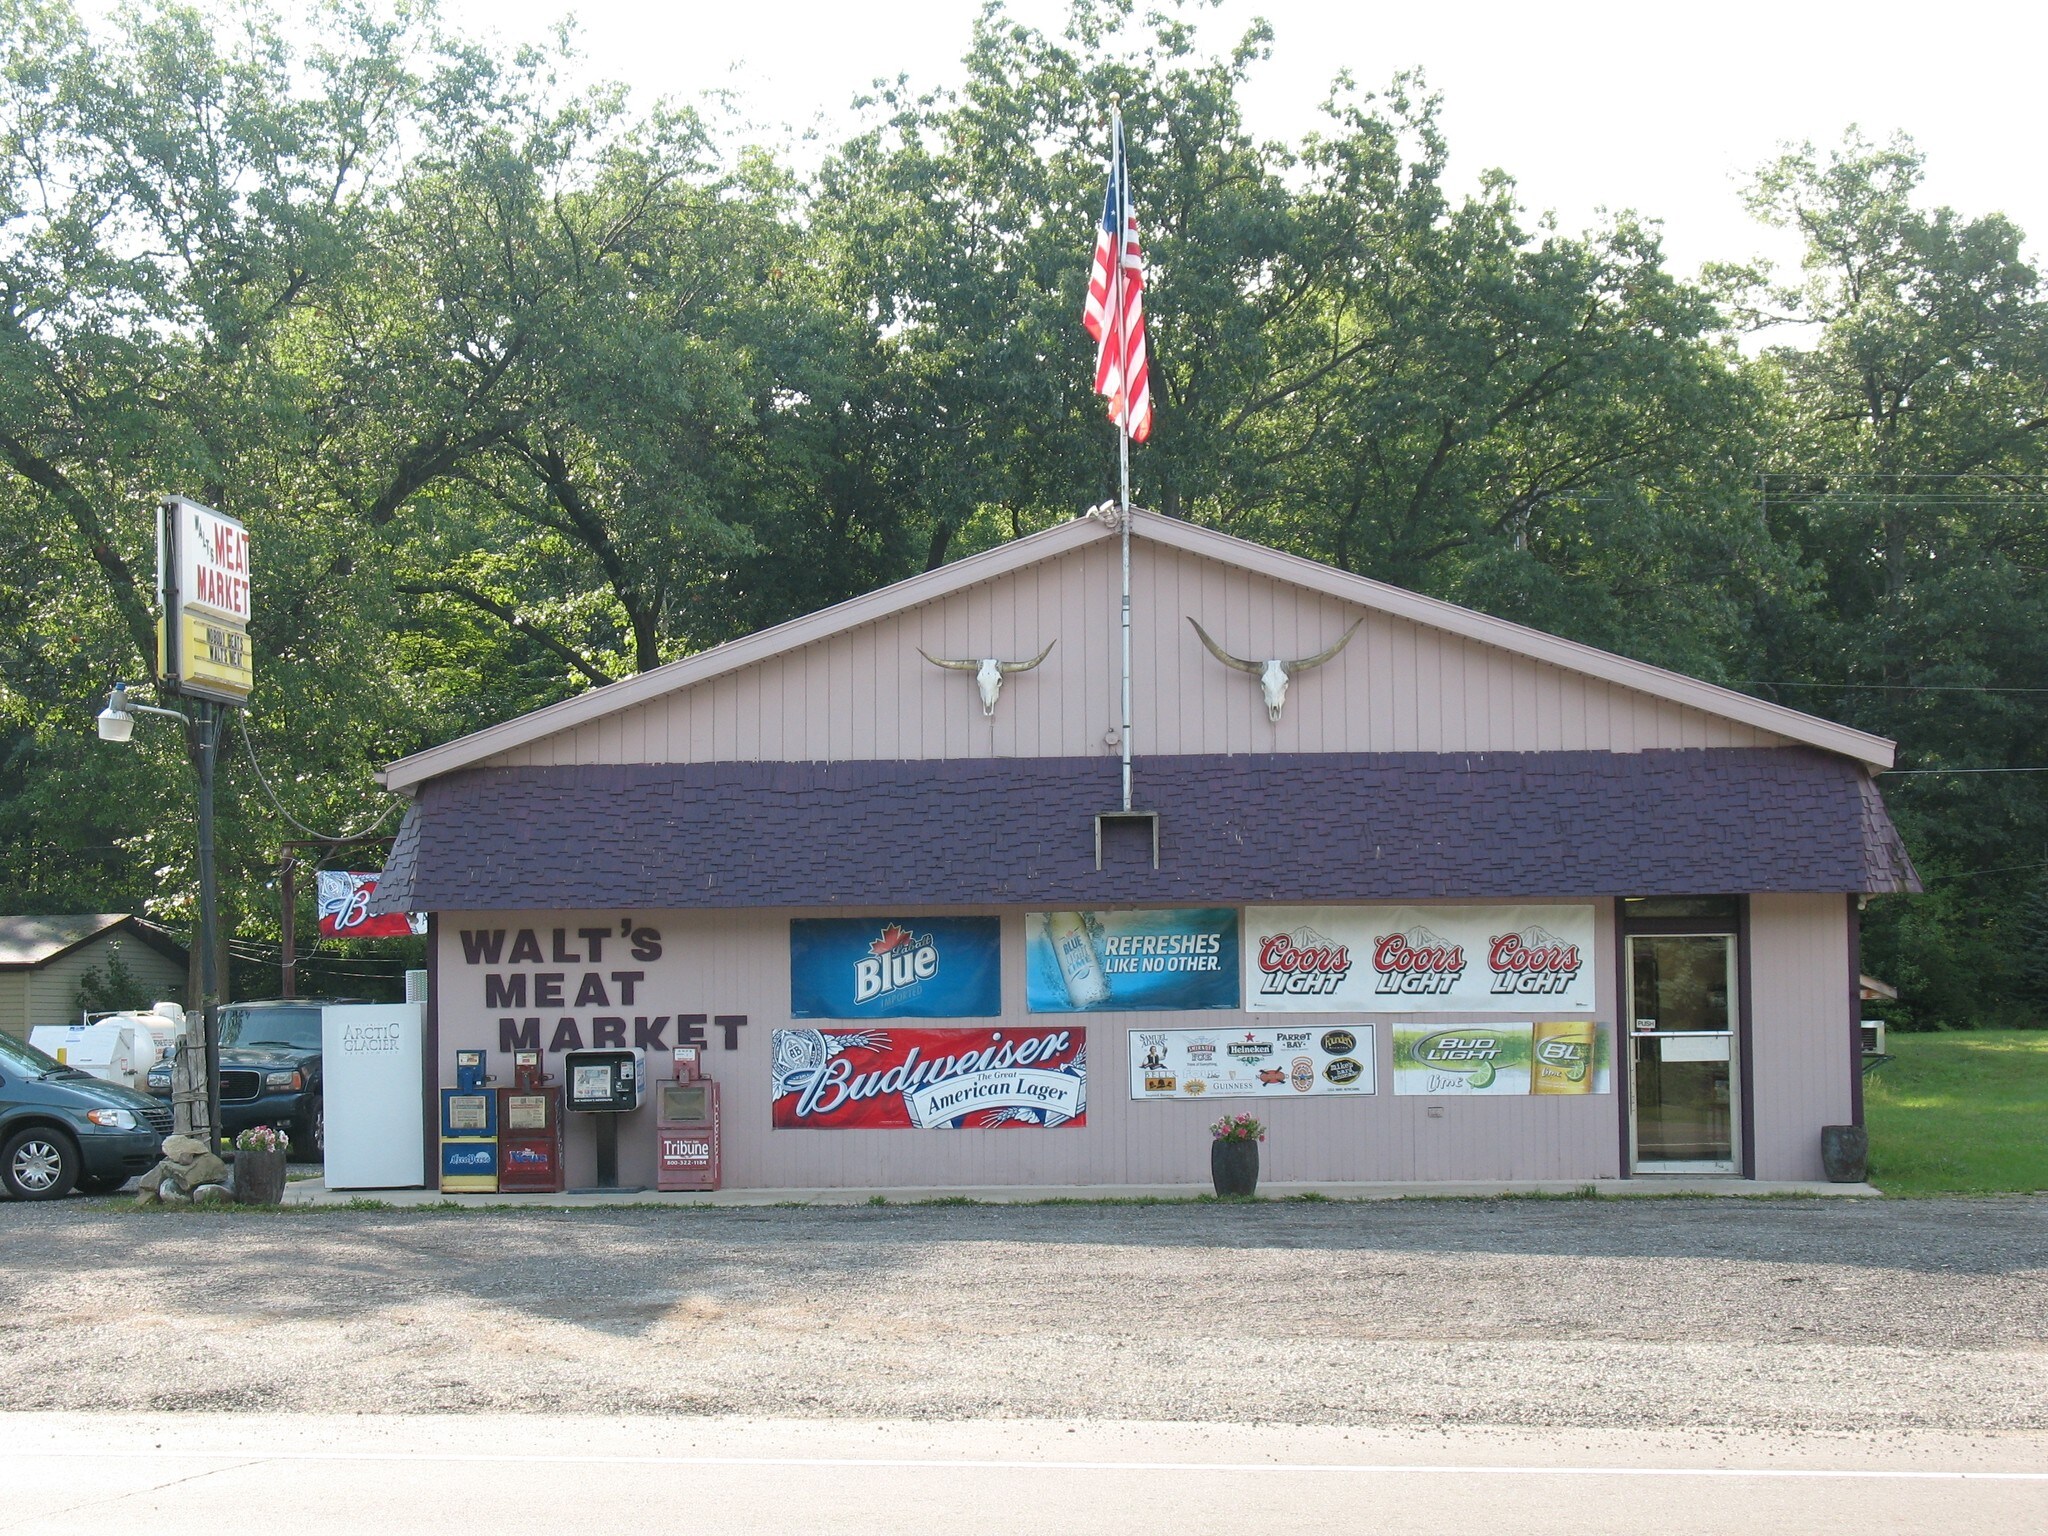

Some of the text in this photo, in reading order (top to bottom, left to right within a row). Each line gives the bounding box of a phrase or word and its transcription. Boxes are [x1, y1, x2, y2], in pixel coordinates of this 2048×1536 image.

[214, 522, 249, 576] MEAT
[197, 564, 248, 615] MARKET
[459, 918, 663, 964] WALT'S
[1063, 936, 1083, 955] BLUE
[1104, 933, 1221, 956] REFRESHES
[1258, 933, 1352, 973] Coors
[1372, 933, 1467, 973] Coors
[1487, 932, 1583, 973] Coors
[855, 945, 938, 1004] Blue
[1105, 955, 1222, 973] LIKE NO OTHER.
[486, 971, 645, 1008] MEAT
[1260, 972, 1346, 994] LIGHT
[1375, 972, 1461, 994] LIGHT
[1490, 972, 1577, 994] LIGHT
[499, 1013, 748, 1053] MARKET
[1277, 1033, 1312, 1041] PARROT
[1437, 1038, 1495, 1049] BUD
[1231, 1045, 1270, 1054] Heineken
[1427, 1050, 1502, 1060] LIGHT
[1543, 1043, 1581, 1060] BL
[780, 1031, 1069, 1117] Budweiser
[977, 1071, 1017, 1081] The Great
[1427, 1074, 1464, 1092] Lime
[928, 1078, 1068, 1115] American Lager
[664, 1140, 709, 1155] Tribune
